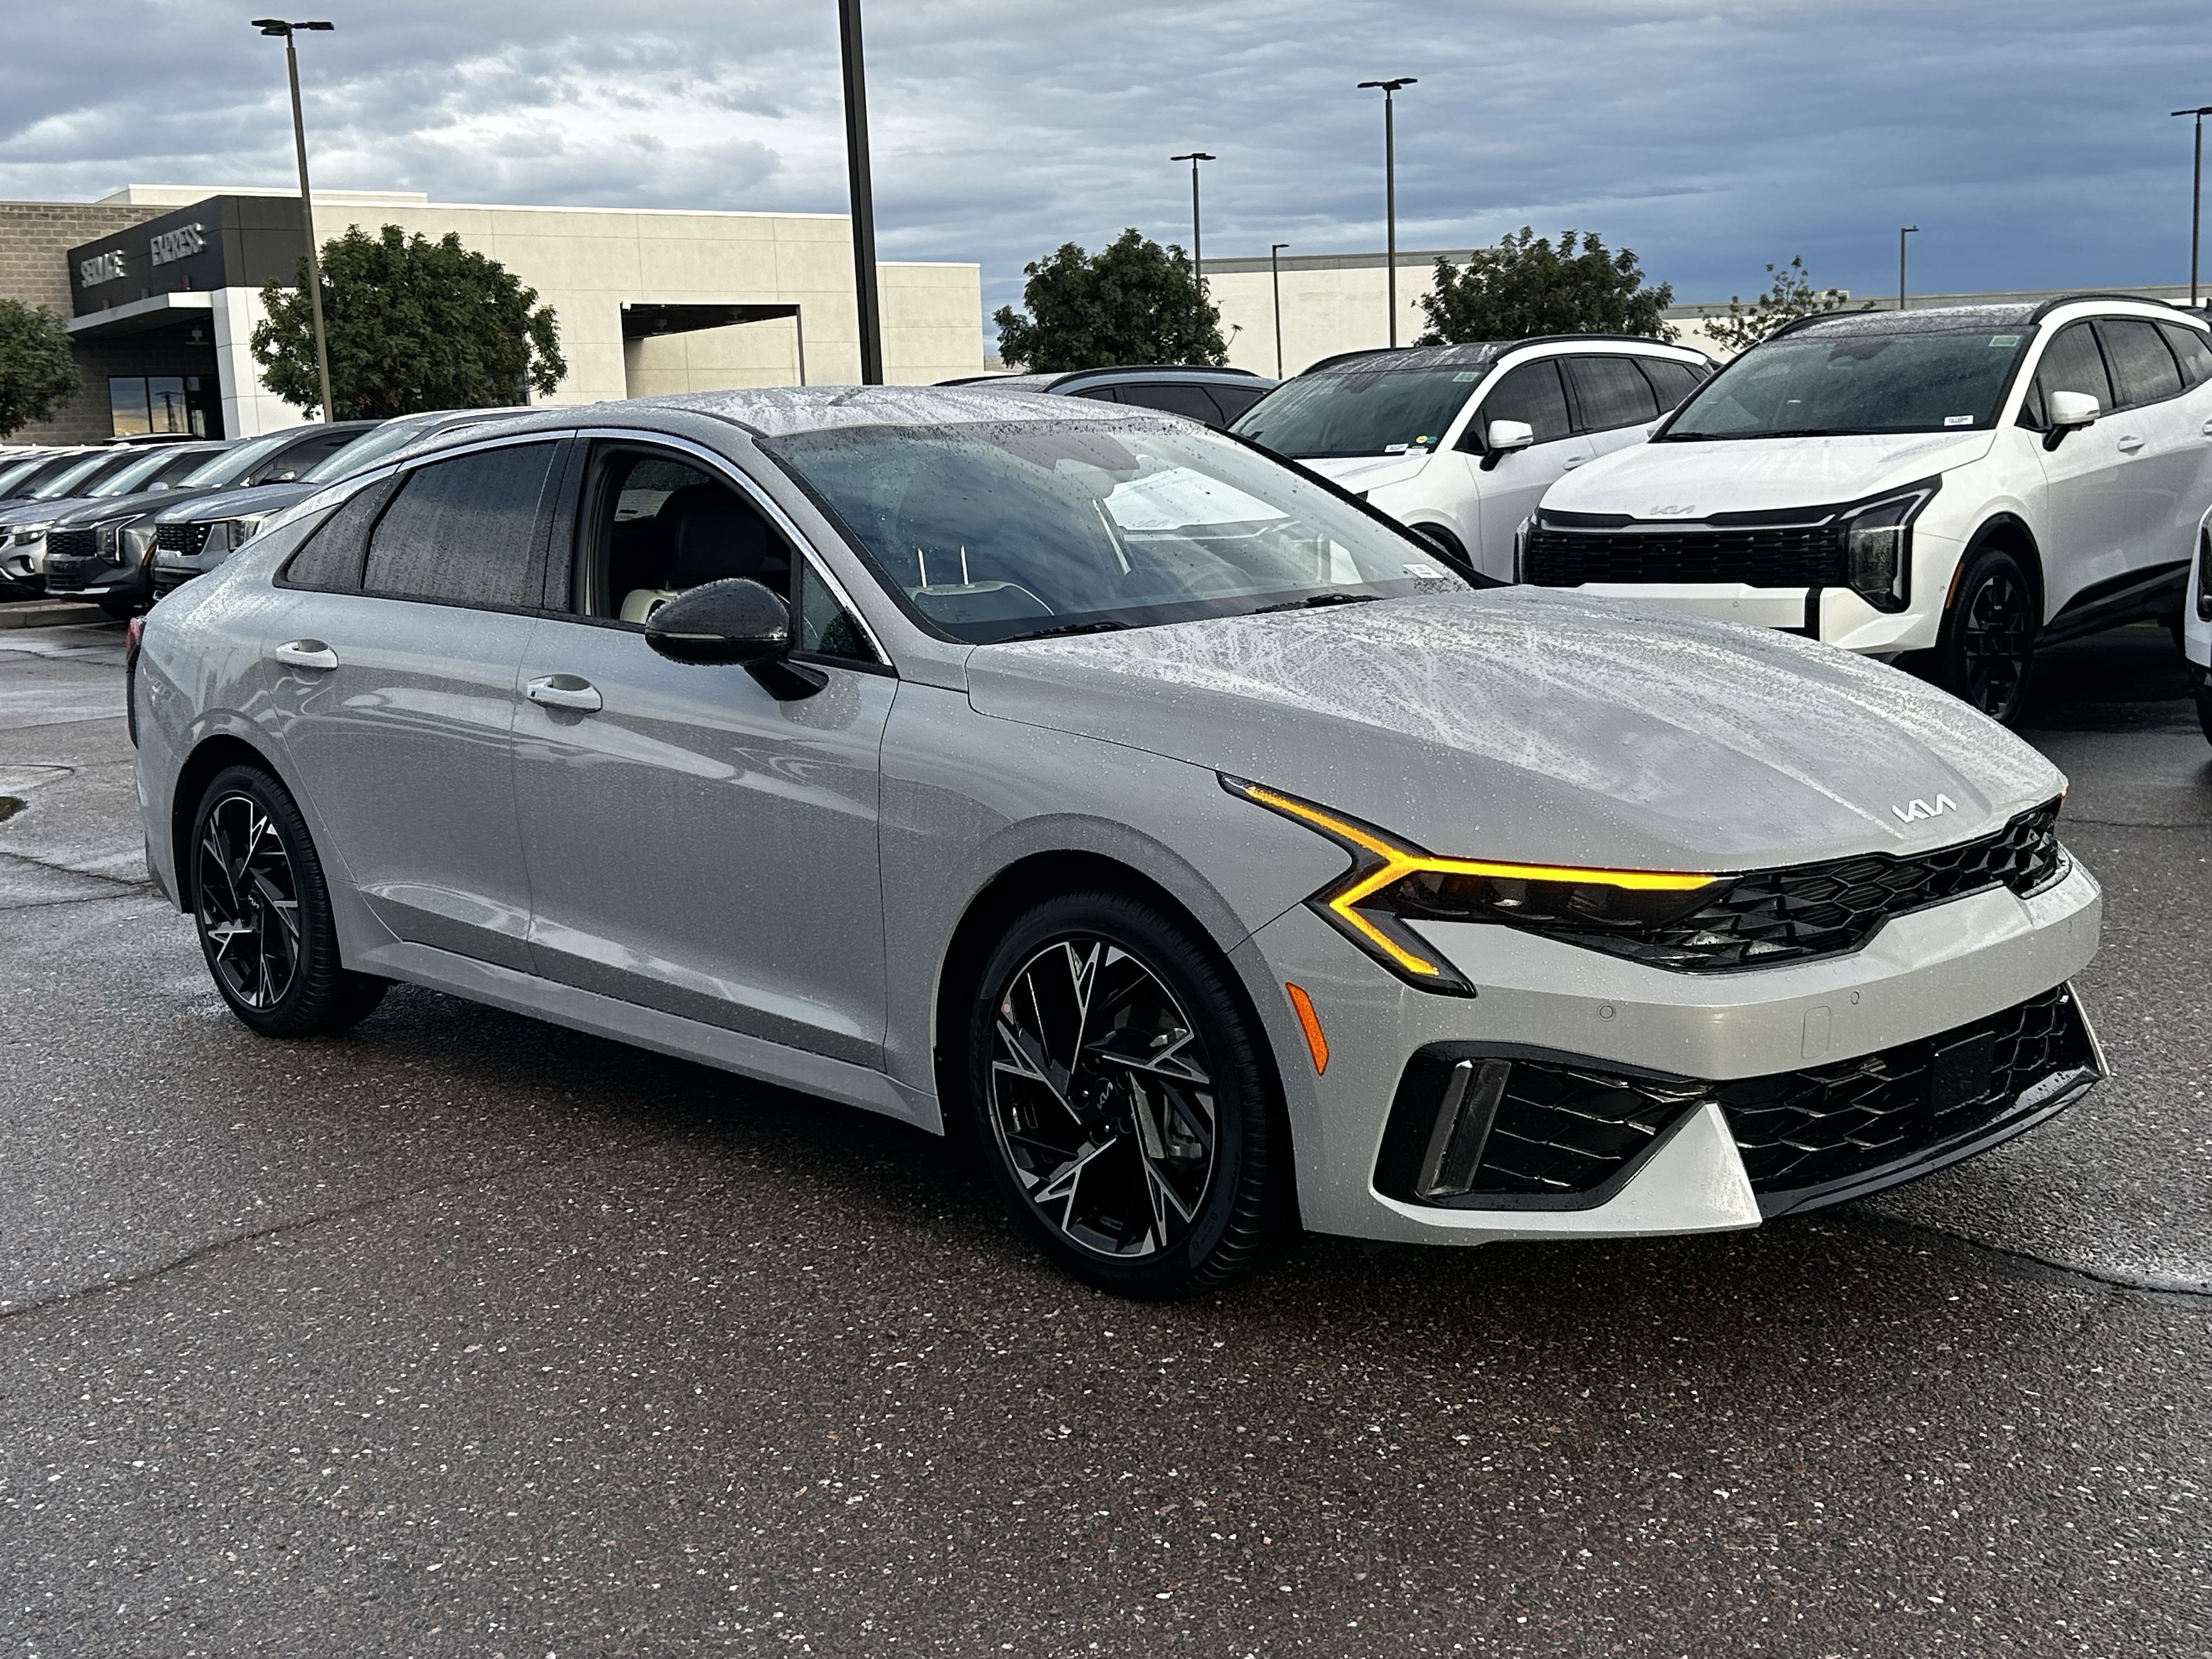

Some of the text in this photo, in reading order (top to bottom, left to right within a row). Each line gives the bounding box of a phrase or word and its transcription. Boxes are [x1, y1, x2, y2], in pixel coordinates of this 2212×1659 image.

[150, 222, 206, 266] EXPRESS
[1650, 505, 1696, 515] KIA
[1891, 793, 1957, 824] KIA
[1097, 1081, 1114, 1110] KIA
